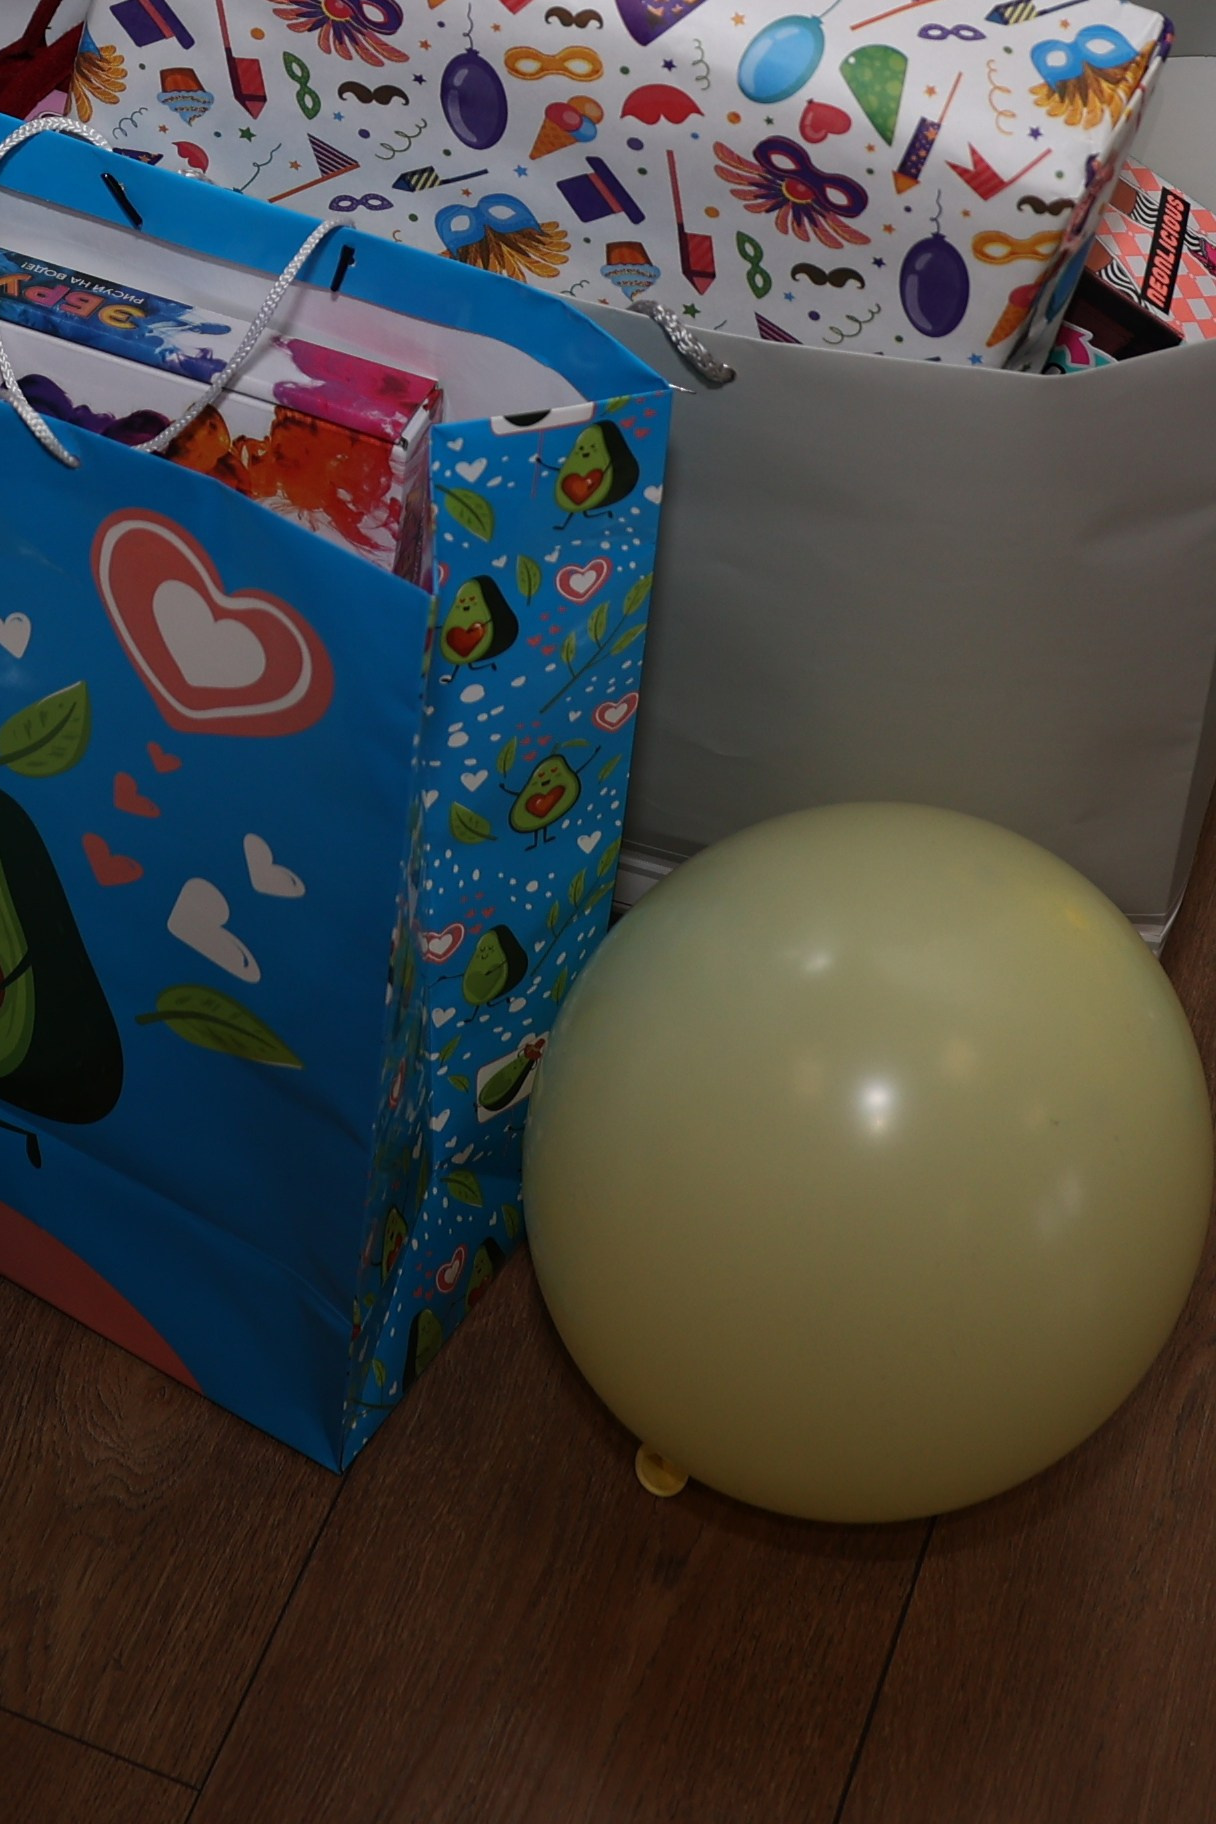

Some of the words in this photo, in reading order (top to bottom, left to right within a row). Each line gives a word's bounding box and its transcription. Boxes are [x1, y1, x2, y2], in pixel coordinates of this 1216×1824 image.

[20, 261, 68, 280] ВОДЕ!
[70, 275, 93, 289] НА
[92, 281, 145, 305] РИСУЙ
